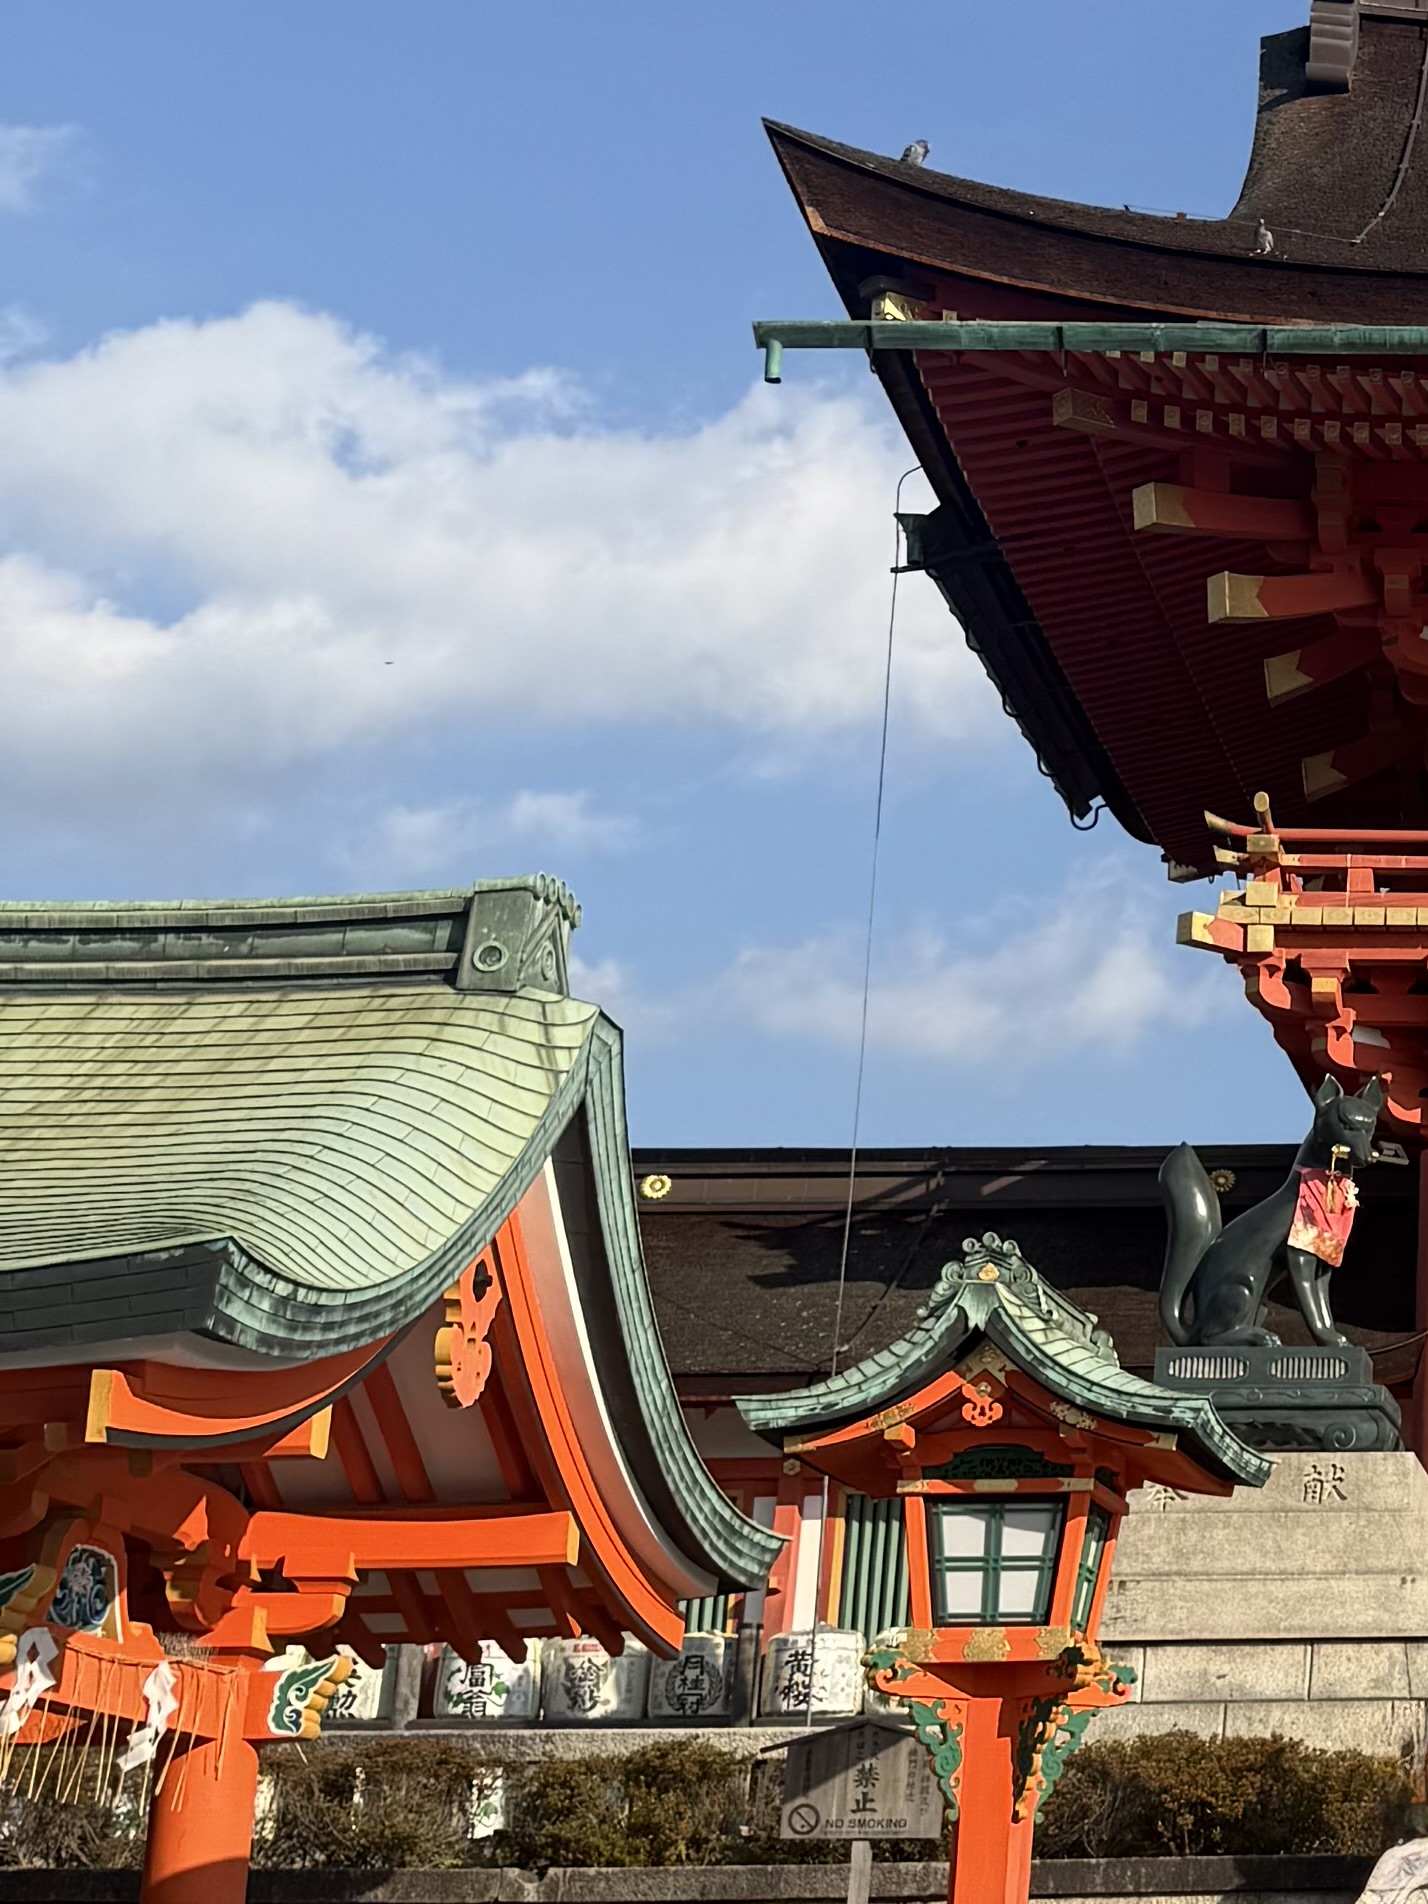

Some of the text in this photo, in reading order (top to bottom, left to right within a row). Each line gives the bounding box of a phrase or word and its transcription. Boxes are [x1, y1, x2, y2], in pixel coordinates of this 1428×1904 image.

[677, 1655, 706, 1715] 月桂冠
[851, 1763, 880, 1814] 禁止
[825, 1818, 907, 1828] NO SMOKING
